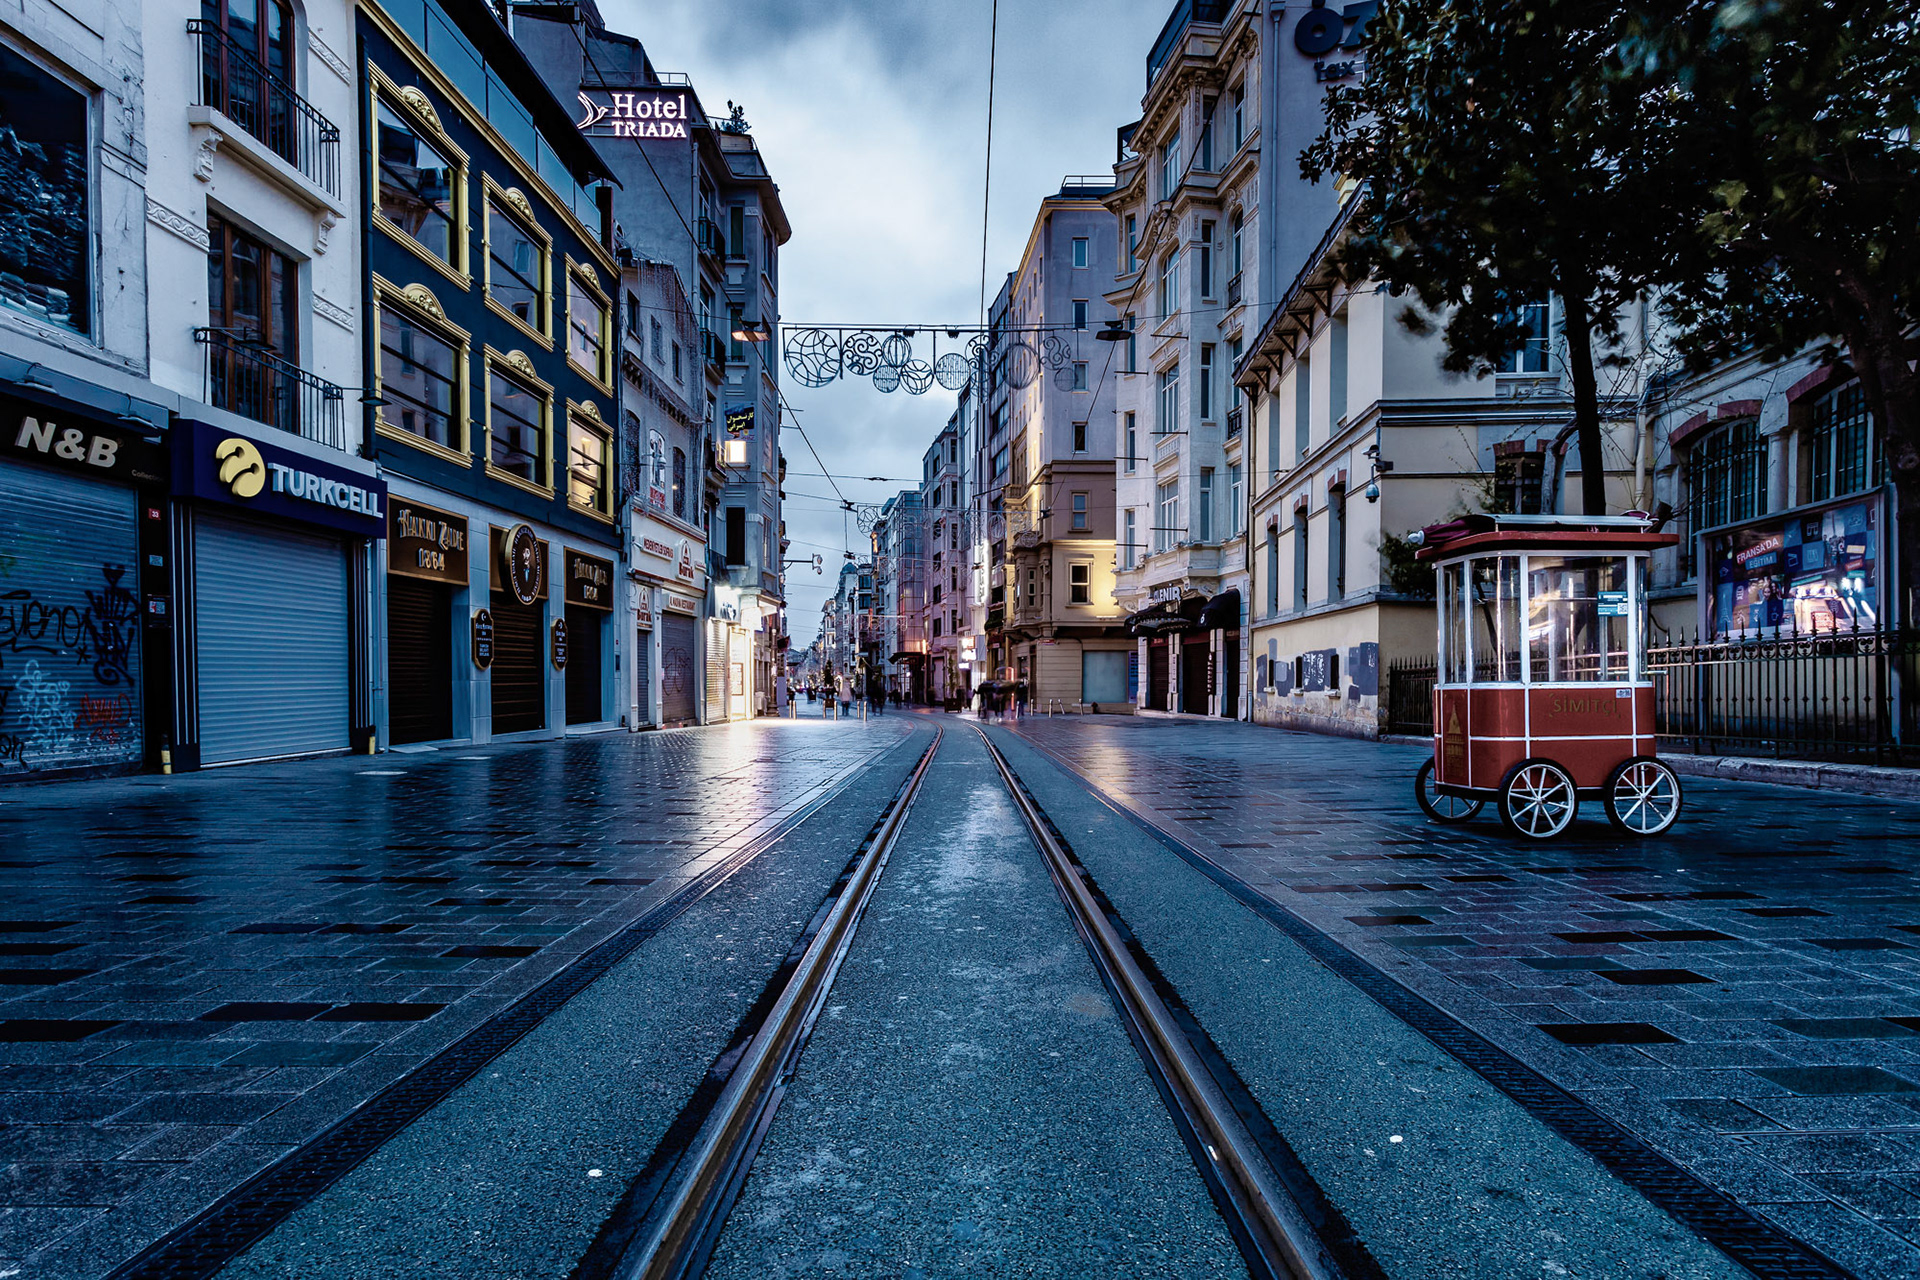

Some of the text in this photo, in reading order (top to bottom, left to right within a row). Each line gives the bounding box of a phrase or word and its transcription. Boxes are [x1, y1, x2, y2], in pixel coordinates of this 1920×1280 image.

[611, 93, 688, 120] Hotel
[611, 121, 688, 138] TRIADA
[14, 415, 119, 468] N&B
[267, 461, 383, 519] TURKCELL
[418, 547, 446, 571] 1864
[1736, 537, 1779, 564] FRANSA'DA
